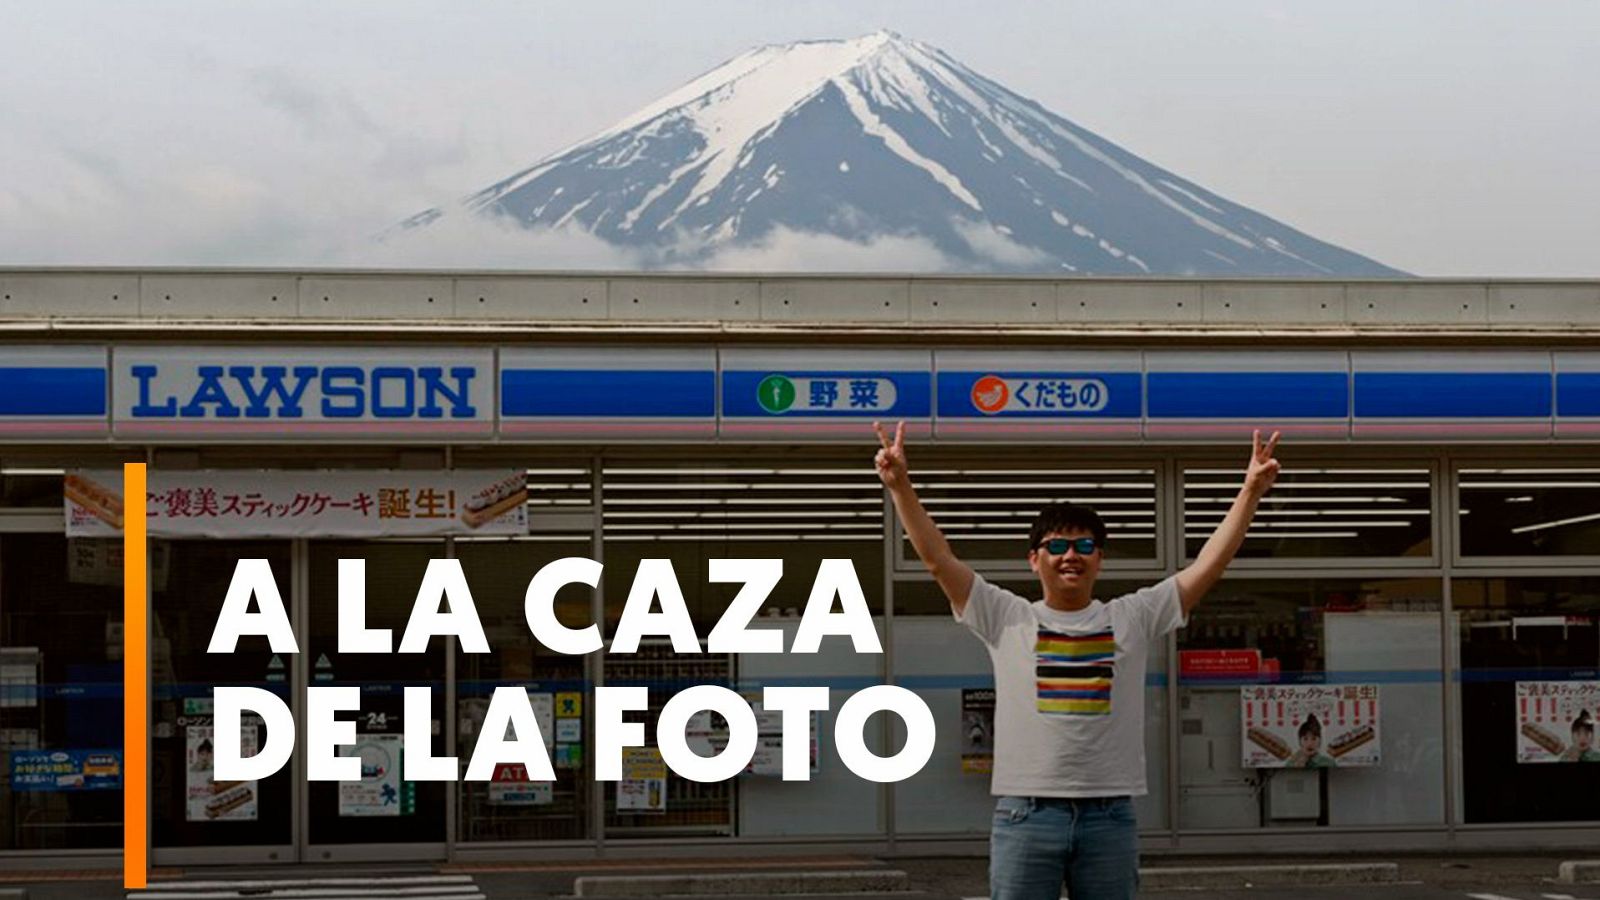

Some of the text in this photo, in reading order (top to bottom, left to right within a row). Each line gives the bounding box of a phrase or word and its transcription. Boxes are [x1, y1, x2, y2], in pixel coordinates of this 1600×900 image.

[131, 364, 476, 419] LAWSON
[810, 378, 879, 411] 野菜
[1016, 379, 1101, 411] くだもの
[366, 711, 387, 725] 24
